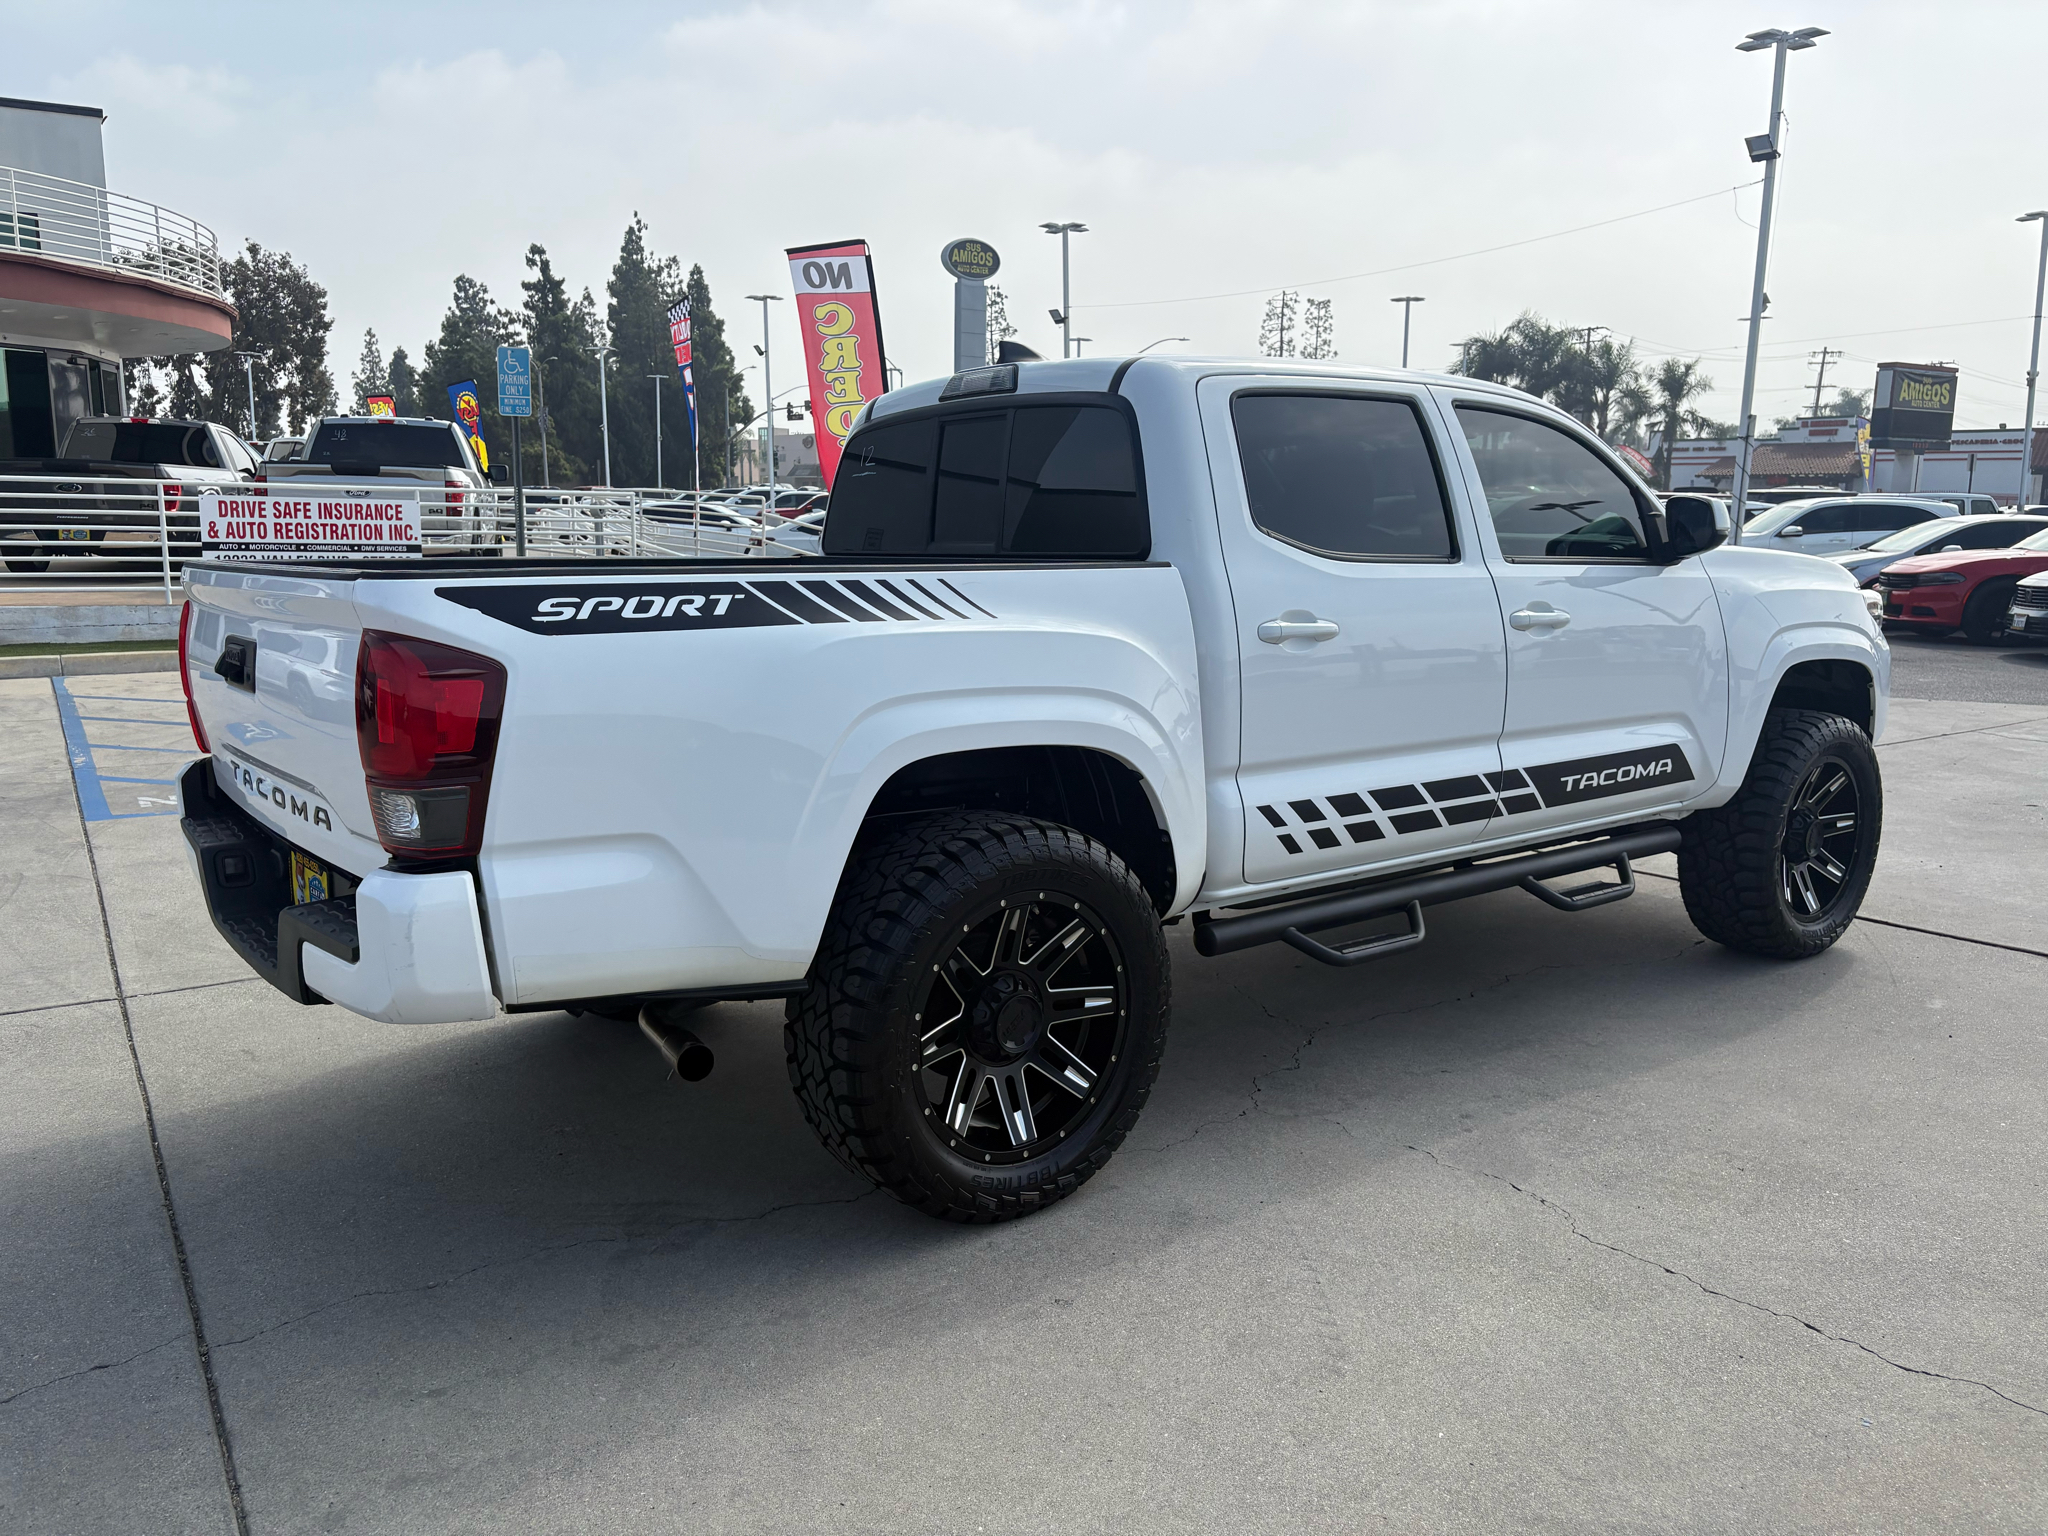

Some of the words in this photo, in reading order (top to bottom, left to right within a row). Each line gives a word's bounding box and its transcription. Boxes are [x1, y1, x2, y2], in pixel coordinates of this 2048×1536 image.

[966, 242, 982, 252] SUS
[952, 248, 993, 266] AMIGOS
[958, 264, 970, 272] AUTO
[971, 266, 989, 274] CENTER
[500, 374, 528, 385] PARKING
[506, 385, 524, 396] ONLY
[1899, 379, 1950, 405] AMIGOS
[504, 398, 526, 406] MINIMUM
[1911, 400, 1922, 408] AUTO
[1924, 400, 1940, 408] CENTER
[501, 406, 512, 414] FINE
[515, 406, 530, 414] $250
[218, 500, 267, 518] DRIVE
[272, 501, 312, 520] SAFE
[318, 502, 403, 521] INSURANCE
[208, 521, 220, 539] &
[225, 522, 268, 540] AUTO
[274, 522, 383, 541] REGISTRATION
[388, 524, 418, 542] INC.
[531, 594, 745, 622] SPORT
[1560, 758, 1672, 792] TACOMA
[230, 760, 332, 832] TACOMA
